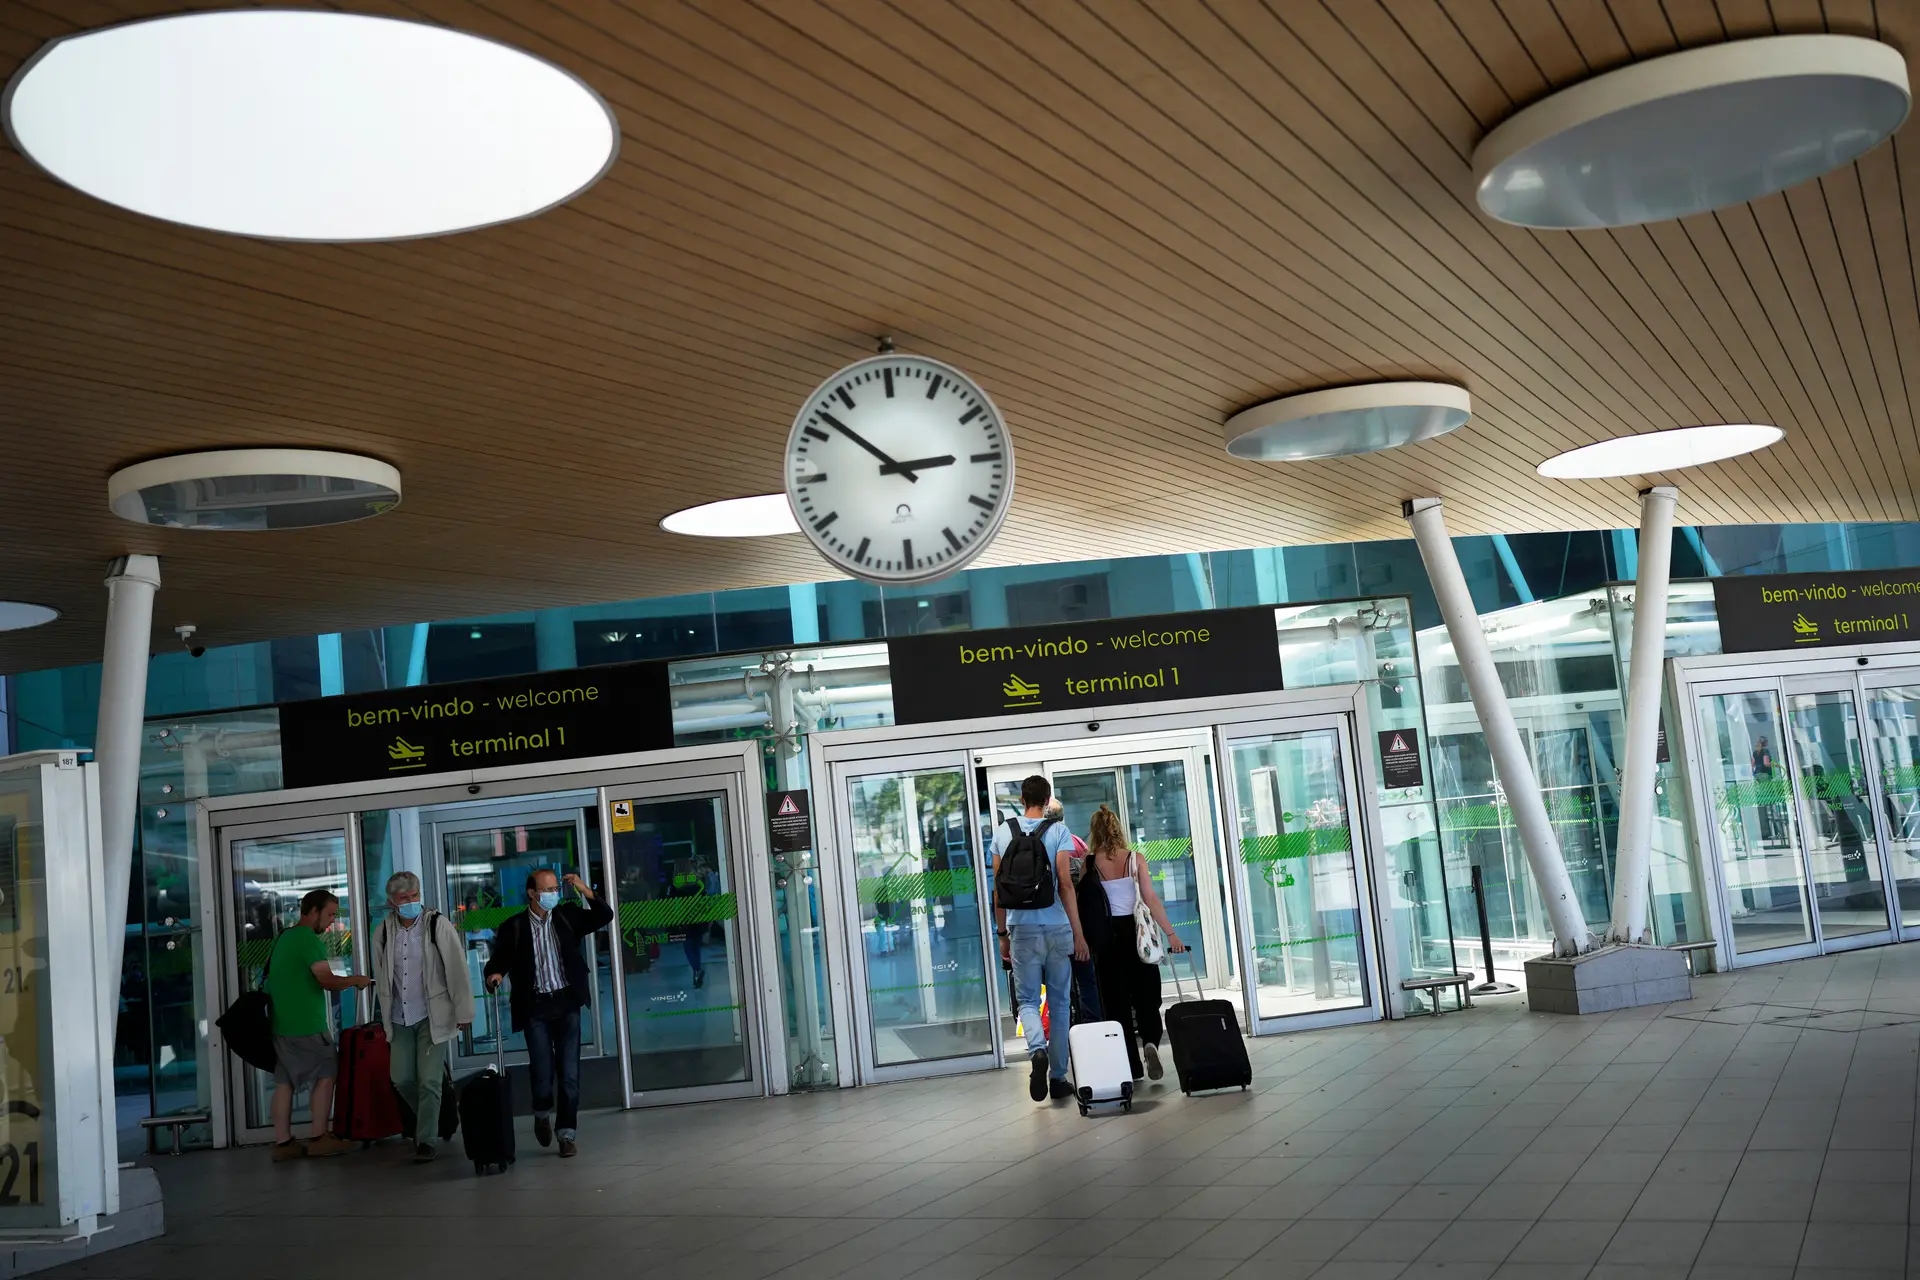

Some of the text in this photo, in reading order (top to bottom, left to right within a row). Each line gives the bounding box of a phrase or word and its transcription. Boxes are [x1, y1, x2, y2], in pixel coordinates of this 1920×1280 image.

[1761, 583, 1847, 604] bem-vindo
[1834, 613, 1909, 634] terminal 1
[959, 635, 1088, 665] bem-vindo
[1110, 627, 1210, 650] welcome
[1065, 667, 1180, 695] terminal 1
[347, 697, 474, 728] bem-vindo
[497, 685, 599, 709] welcome
[450, 727, 565, 758] terminal 1
[62, 758, 74, 766] 187
[650, 994, 676, 1002] VINCI
